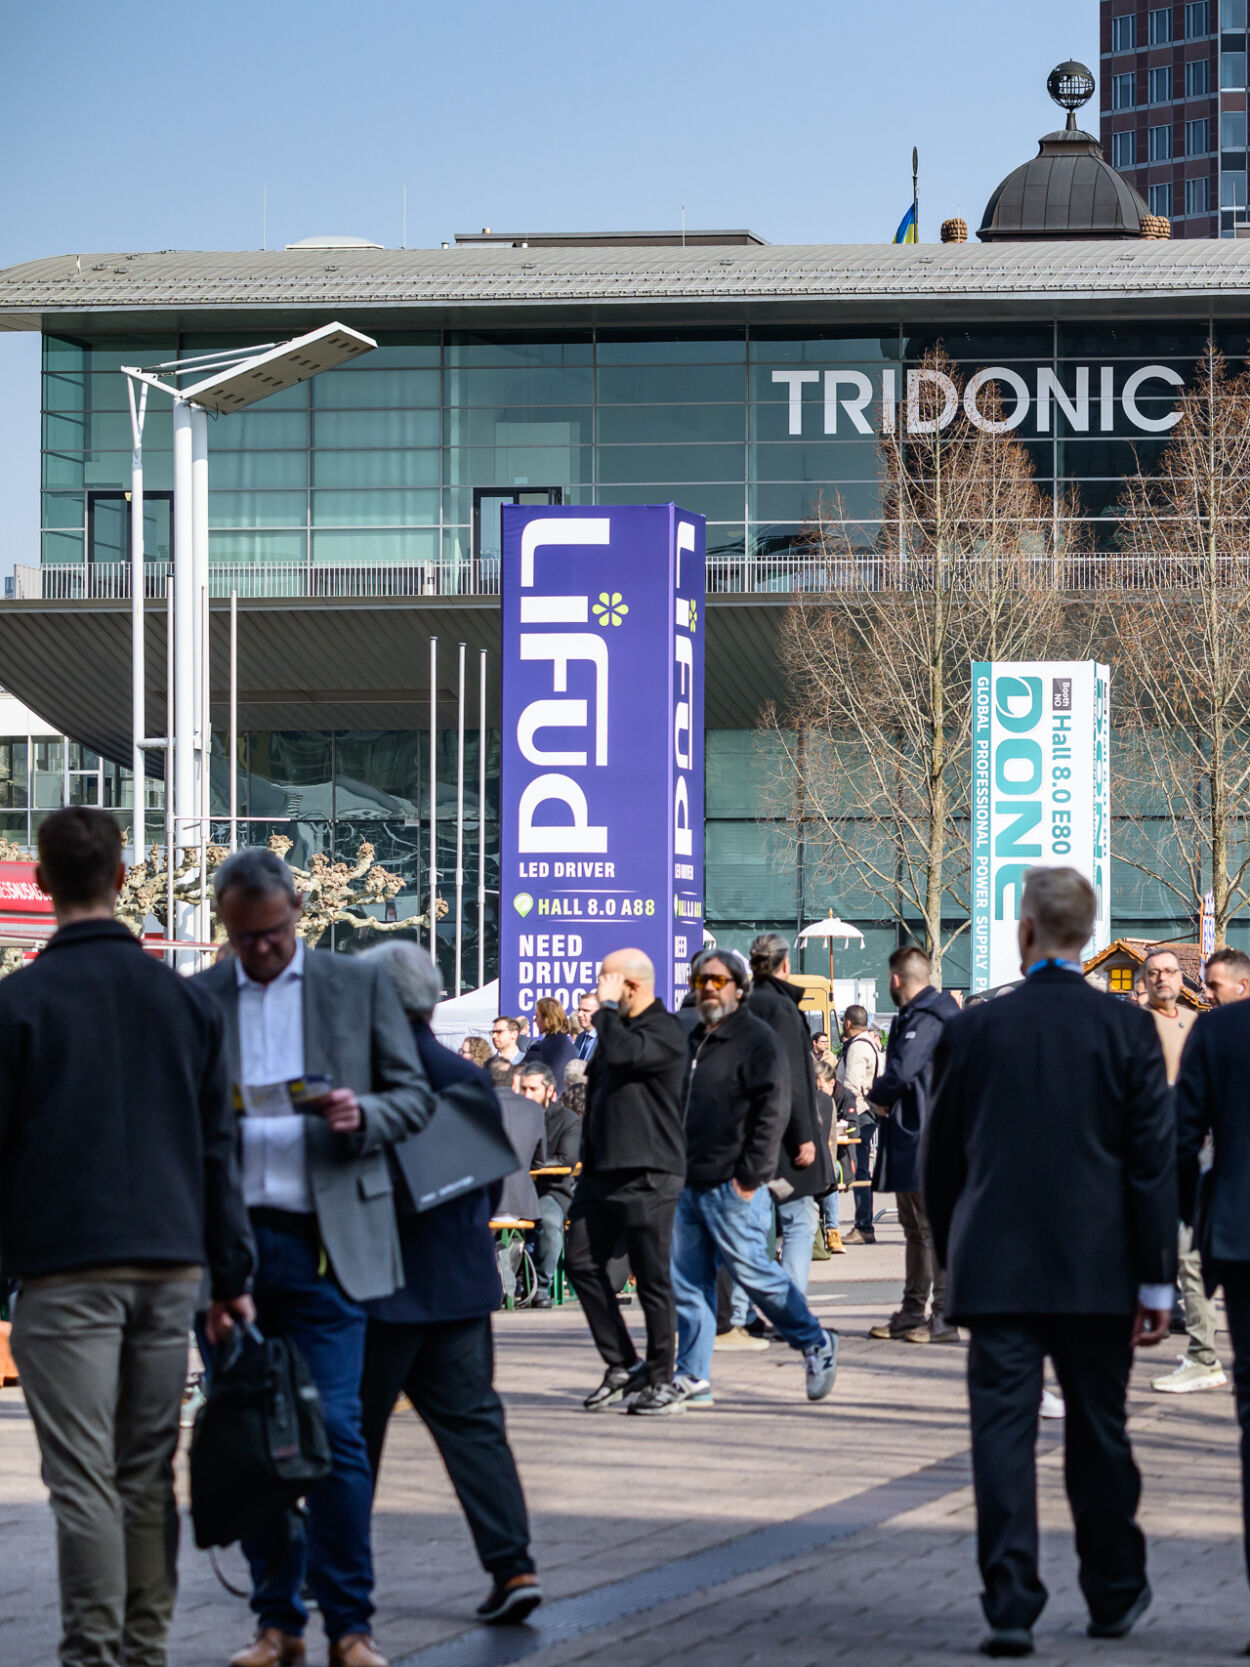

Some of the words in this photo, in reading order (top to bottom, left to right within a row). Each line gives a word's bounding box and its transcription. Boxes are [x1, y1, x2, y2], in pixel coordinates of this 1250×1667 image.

[771, 364, 1186, 435] TRIDONIC
[976, 676, 990, 732] GLOBAL
[1062, 681, 1071, 707] Booth
[1051, 715, 1072, 761] Hall
[975, 740, 990, 849] PROFESSIONAL
[1051, 766, 1072, 804] 8.0
[1051, 810, 1071, 855] E80
[519, 861, 549, 878] LED
[554, 861, 615, 878] DRIVER
[975, 856, 989, 908] POWER
[537, 898, 583, 916] HALL
[587, 898, 617, 916] 8.0
[620, 898, 656, 917] A88
[519, 934, 583, 957] NEED
[974, 915, 988, 969] SUPPLY
